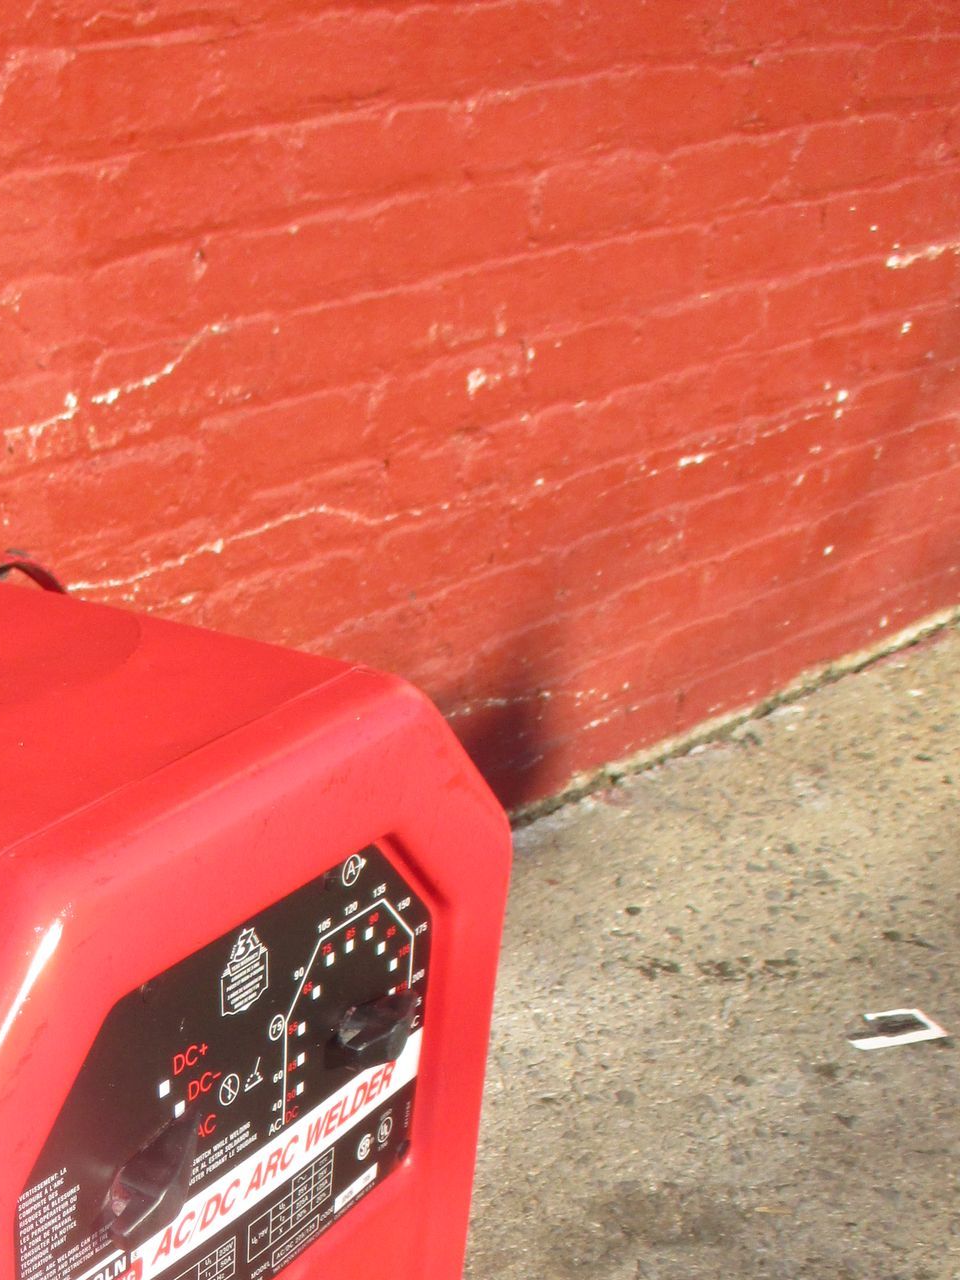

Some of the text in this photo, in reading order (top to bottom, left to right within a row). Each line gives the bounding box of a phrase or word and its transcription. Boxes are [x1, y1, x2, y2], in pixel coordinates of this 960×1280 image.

[318, 882, 386, 934] 105 120 135
[398, 896, 410, 912] 150
[322, 911, 379, 956] 75 85 90
[386, 925, 396, 938] 95
[414, 921, 428, 936] 175
[294, 966, 304, 980] 90
[412, 968, 424, 984] 200
[302, 980, 313, 994] 65
[271, 1020, 282, 1035] 75
[288, 1020, 298, 1035] 55
[172, 1043, 208, 1076] DC+
[273, 1070, 283, 1084] 60
[272, 1087, 296, 1112] 40 30
[269, 1106, 298, 1136] AC DC
[152, 1057, 396, 1268] AC/DC ARC WELDER
[20, 1223, 34, 1238] POUR
[50, 1234, 66, 1250] AVANT
[250, 1260, 270, 1280] MODEL
